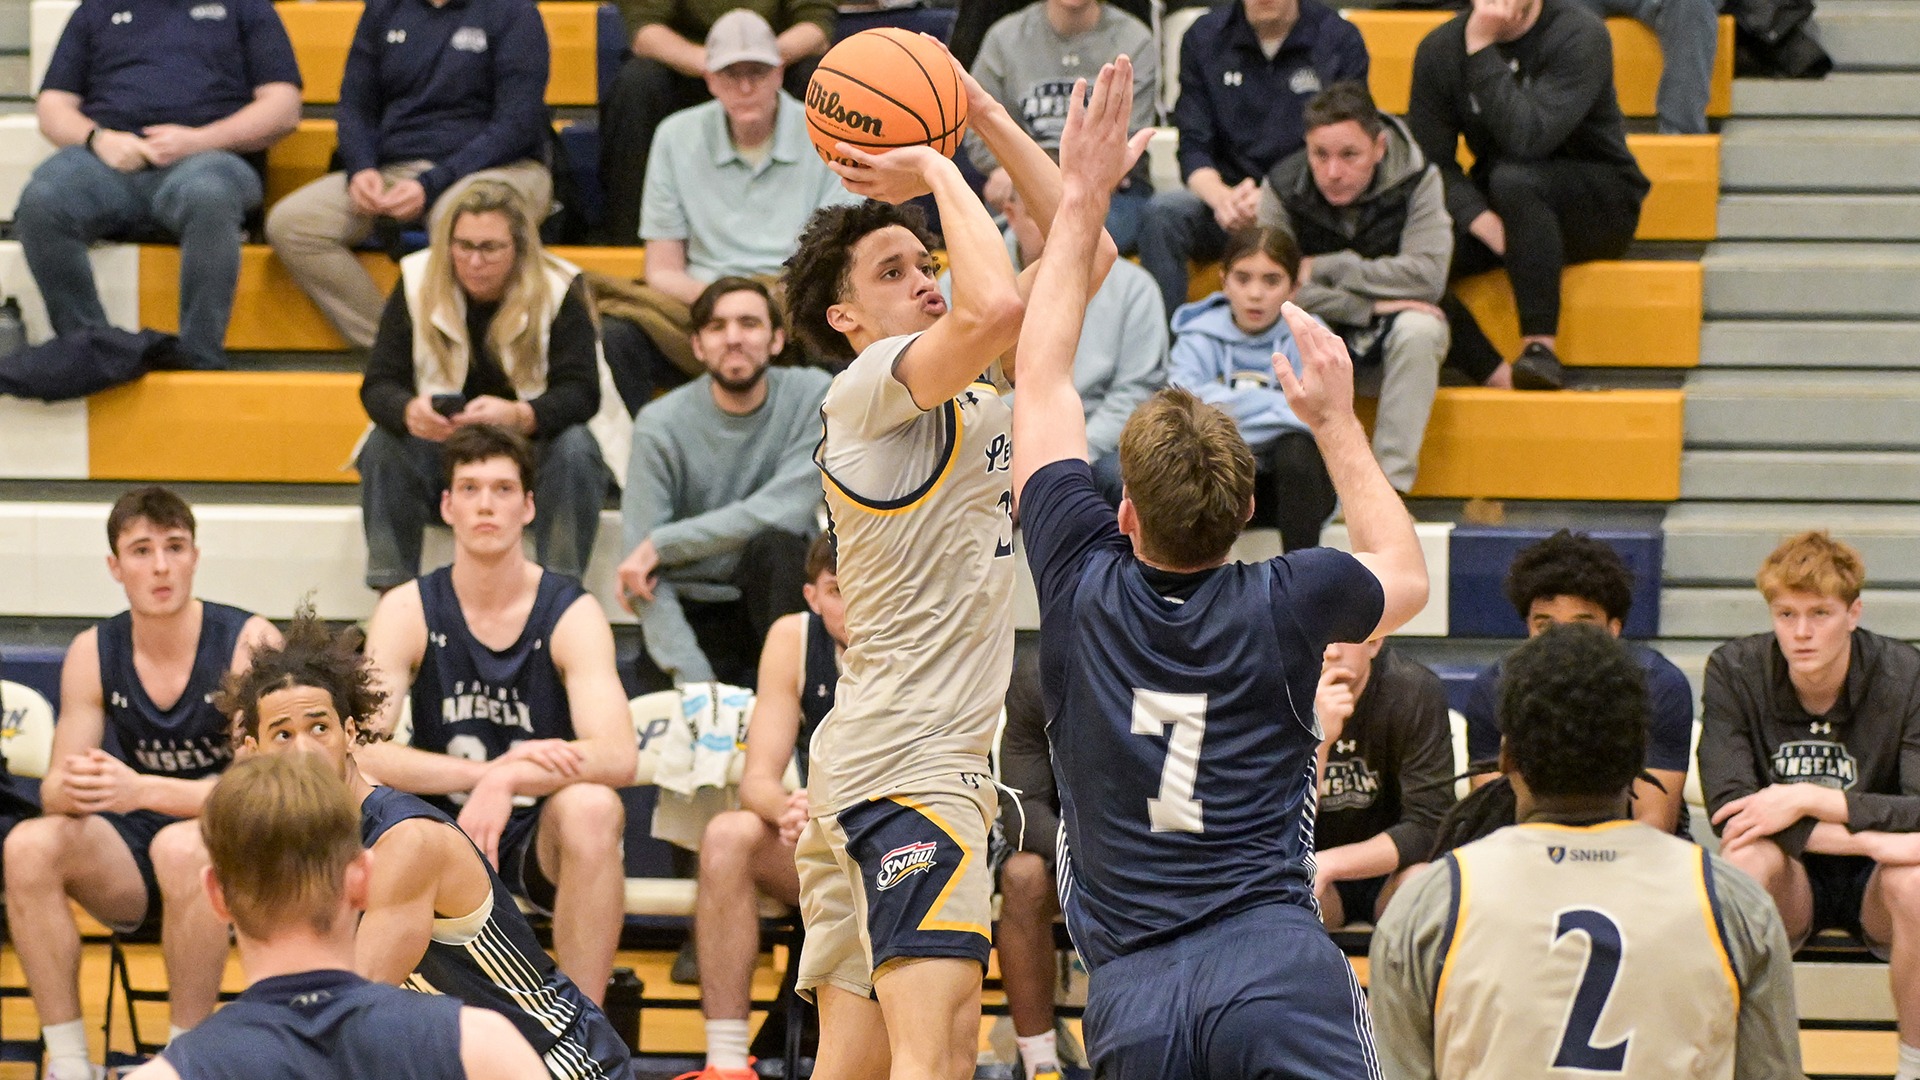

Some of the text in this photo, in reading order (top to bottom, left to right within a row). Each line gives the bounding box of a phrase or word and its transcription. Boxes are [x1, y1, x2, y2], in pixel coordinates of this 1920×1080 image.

[807, 79, 882, 137] Wilson
[984, 432, 1012, 474] PE
[993, 489, 1013, 558] 2
[1131, 687, 1208, 834] 7
[878, 848, 933, 887] SNHU
[1569, 849, 1616, 862] SNHU
[1548, 904, 1636, 1077] 2
